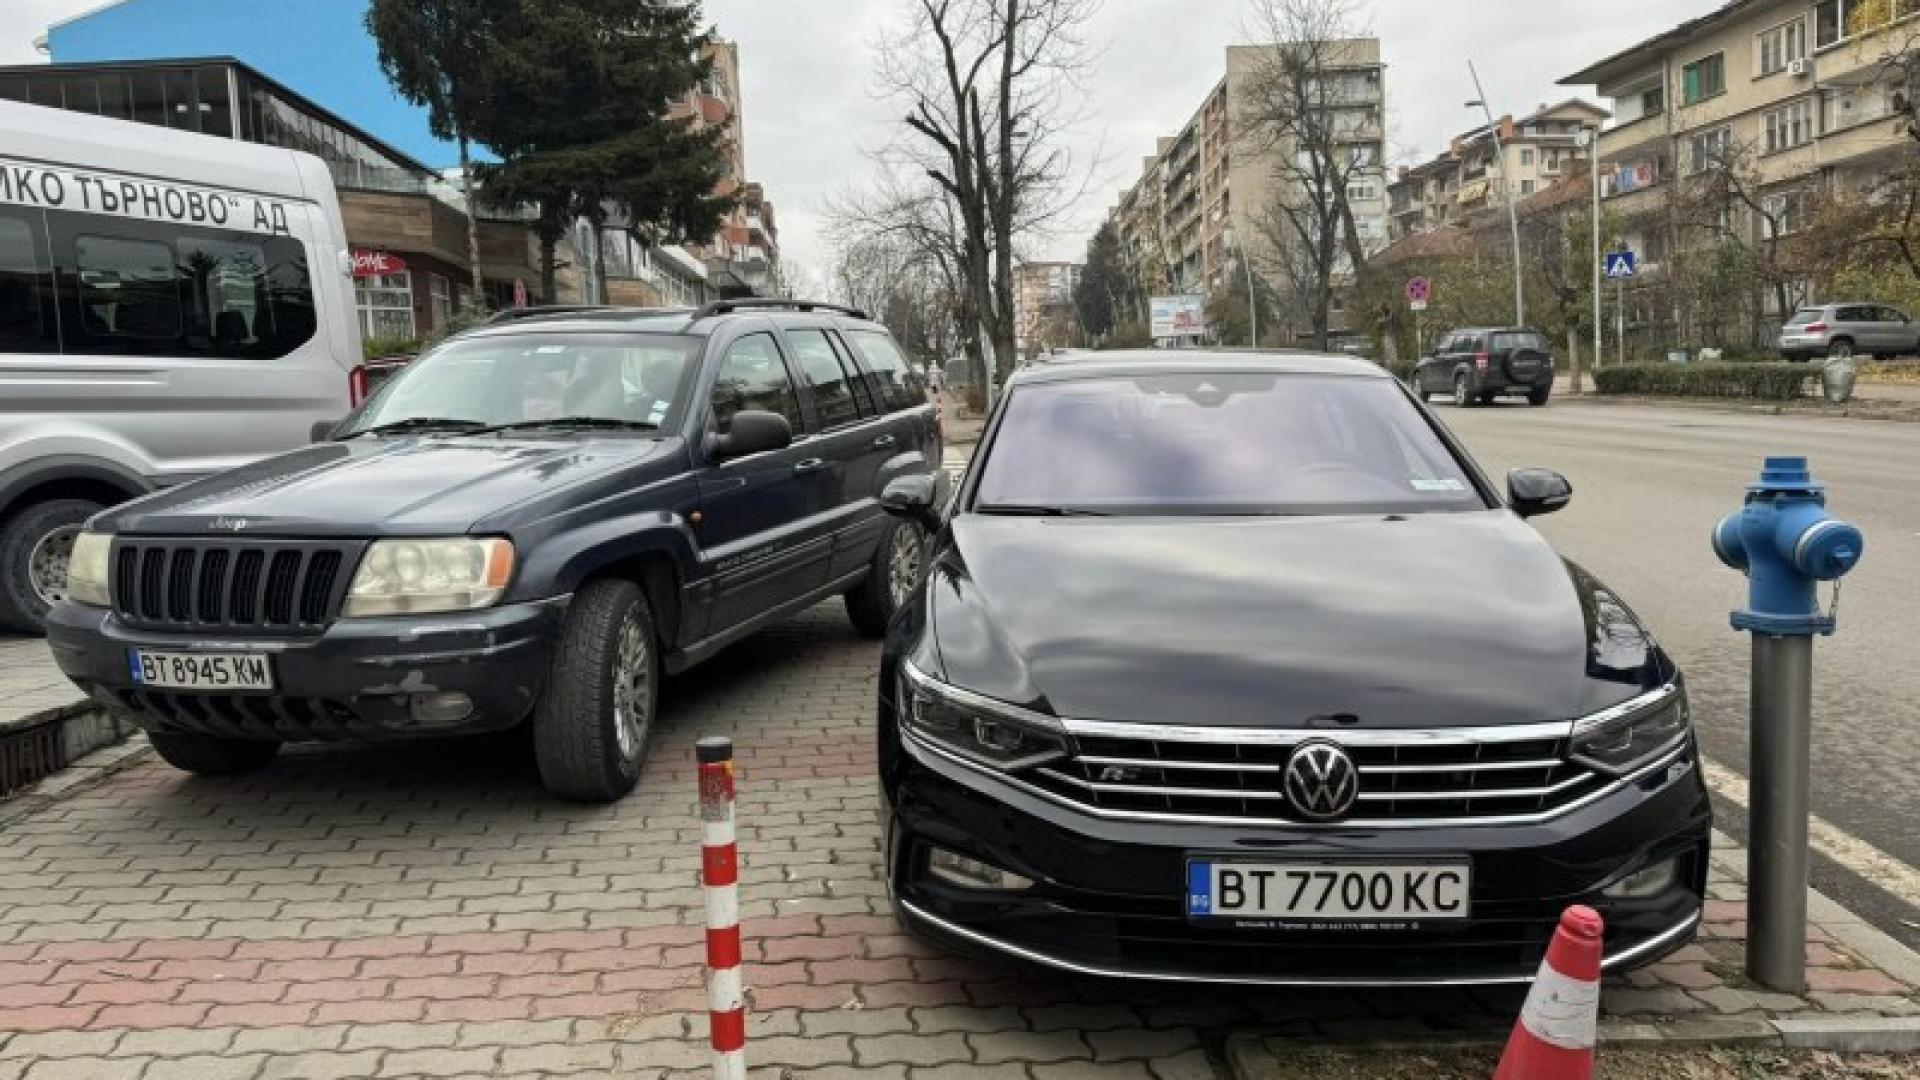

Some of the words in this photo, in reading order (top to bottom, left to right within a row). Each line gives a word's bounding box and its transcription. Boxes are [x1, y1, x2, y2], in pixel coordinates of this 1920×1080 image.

[253, 200, 290, 237] АД
[143, 656, 167, 683] BT
[172, 657, 229, 685] 8945
[232, 657, 266, 685] KM
[1218, 869, 1275, 910] BT
[1285, 871, 1394, 912] 7700
[1403, 871, 1461, 912] KC
